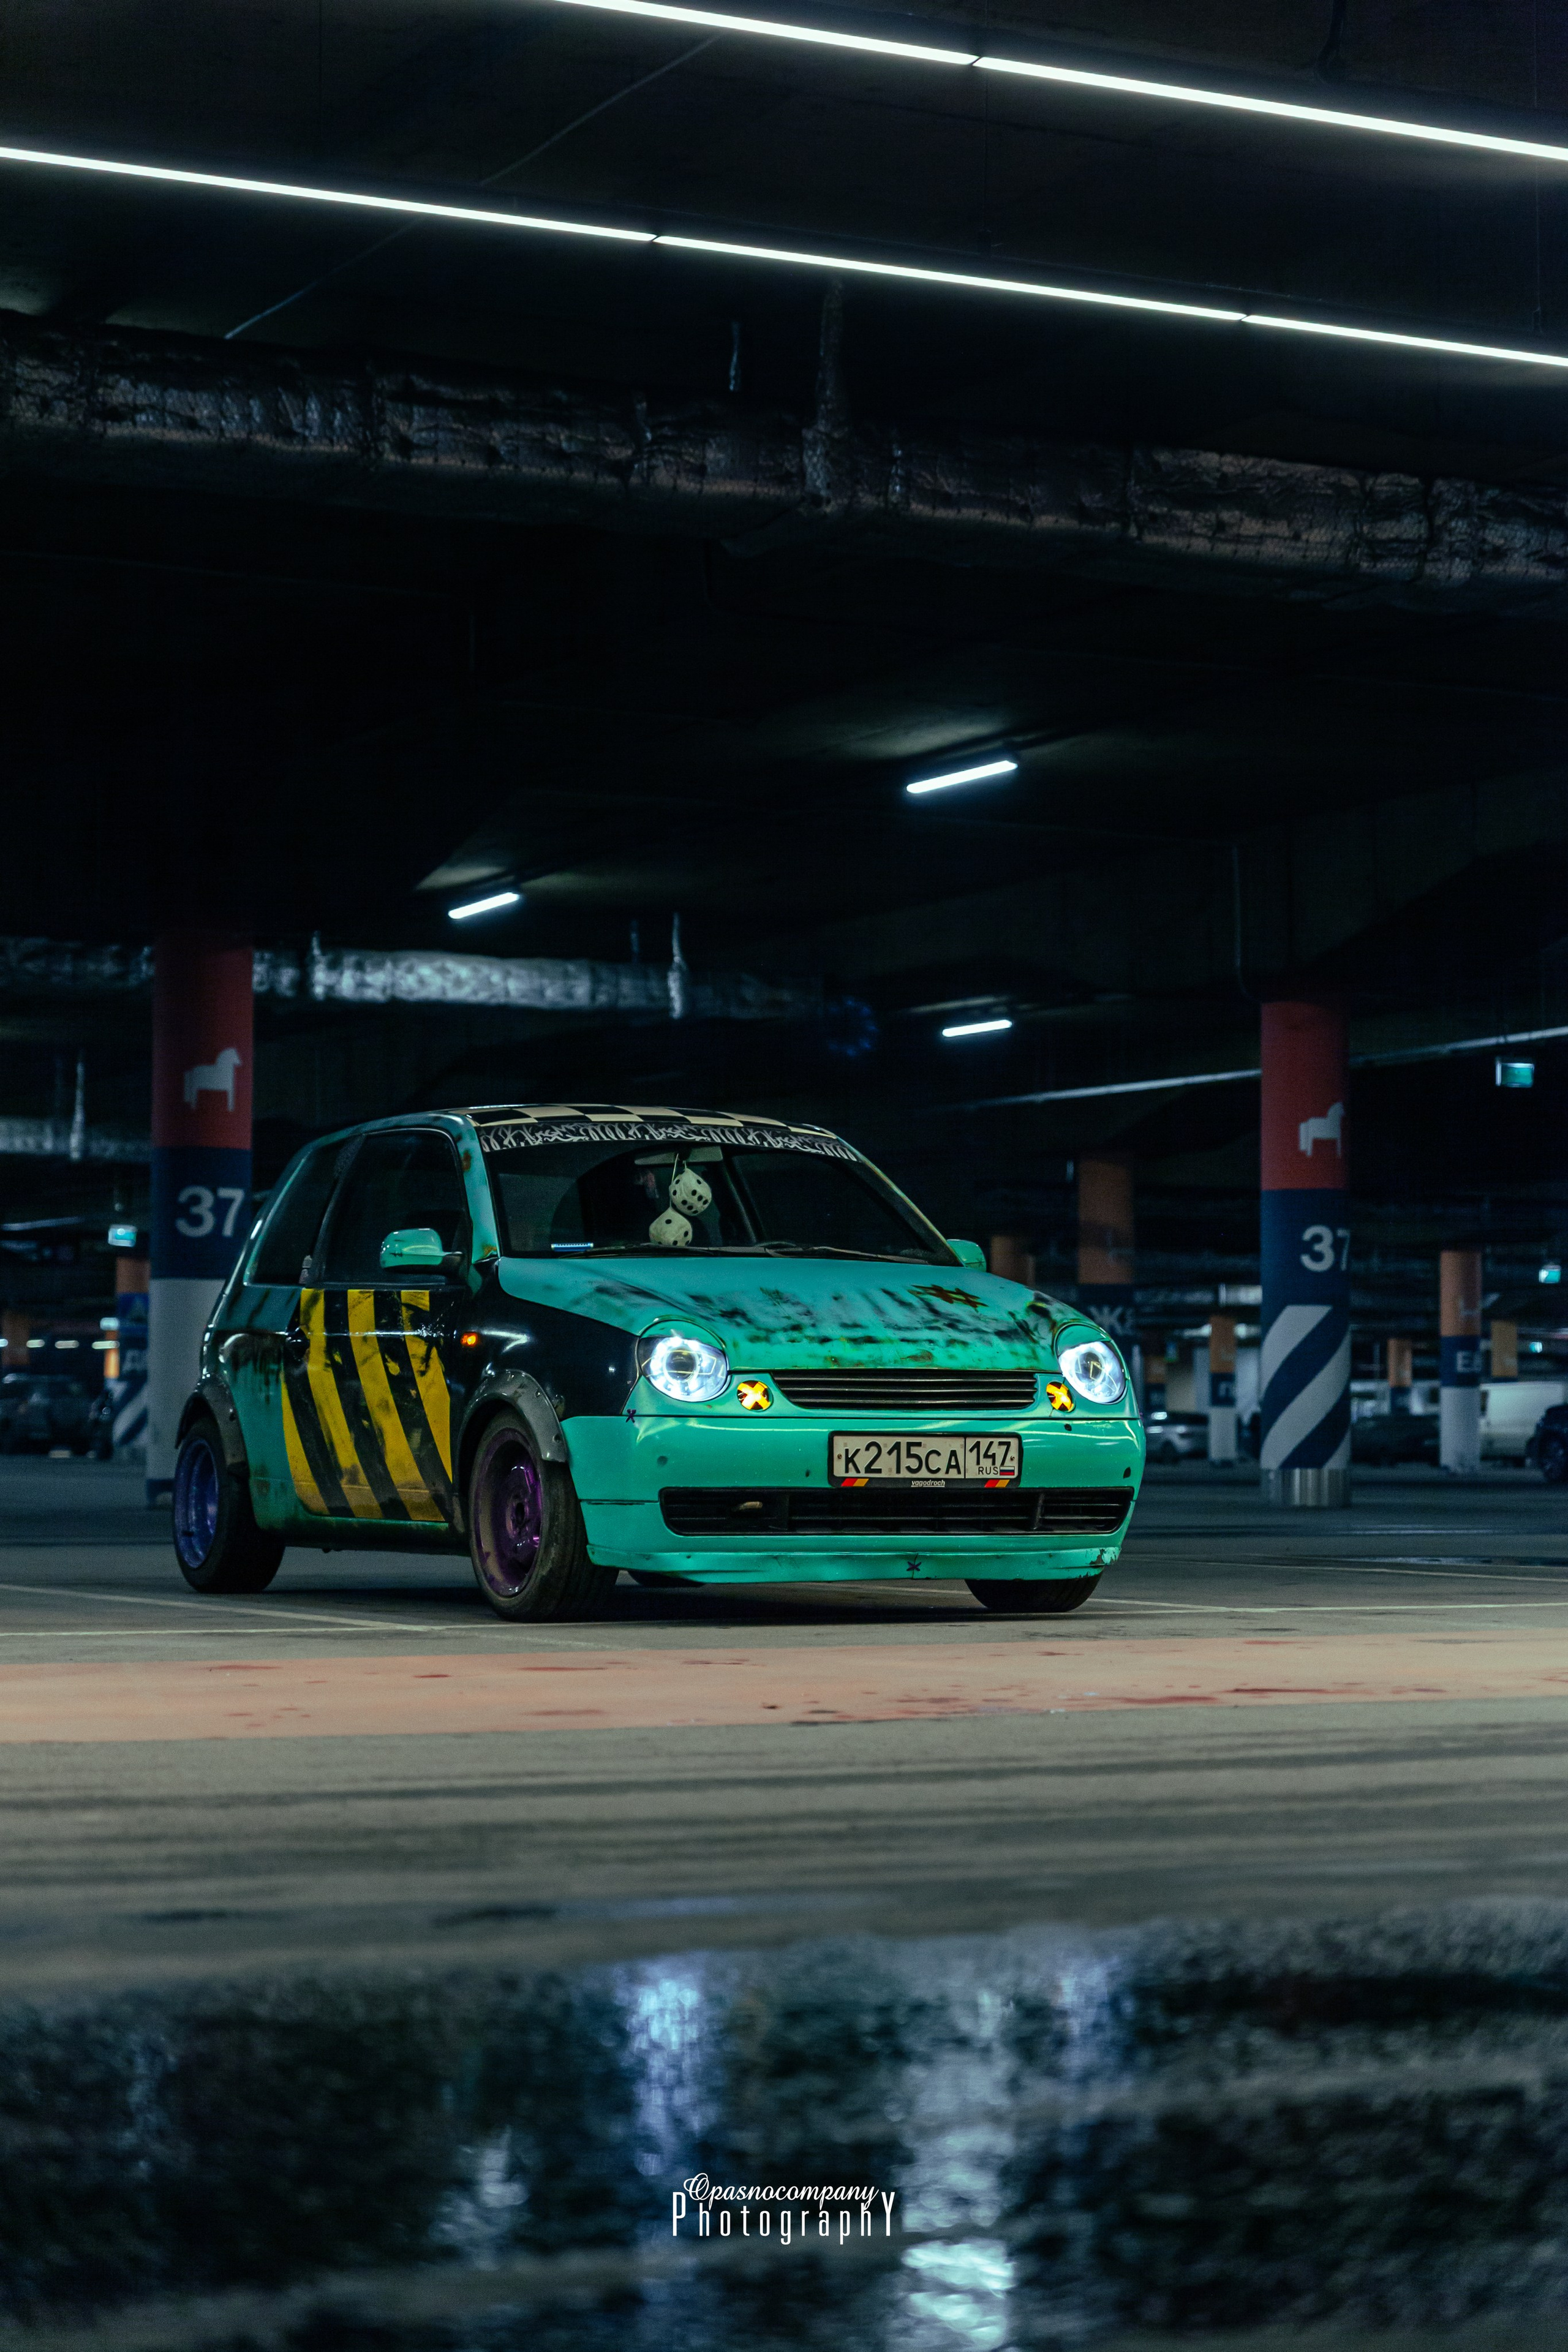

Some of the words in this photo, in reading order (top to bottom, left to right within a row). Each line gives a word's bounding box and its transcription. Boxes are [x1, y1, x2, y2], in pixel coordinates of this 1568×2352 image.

[175, 1185, 245, 1237] 37
[1300, 1224, 1351, 1272] 37
[968, 1441, 1011, 1466] 147
[978, 1466, 998, 1475] RUS
